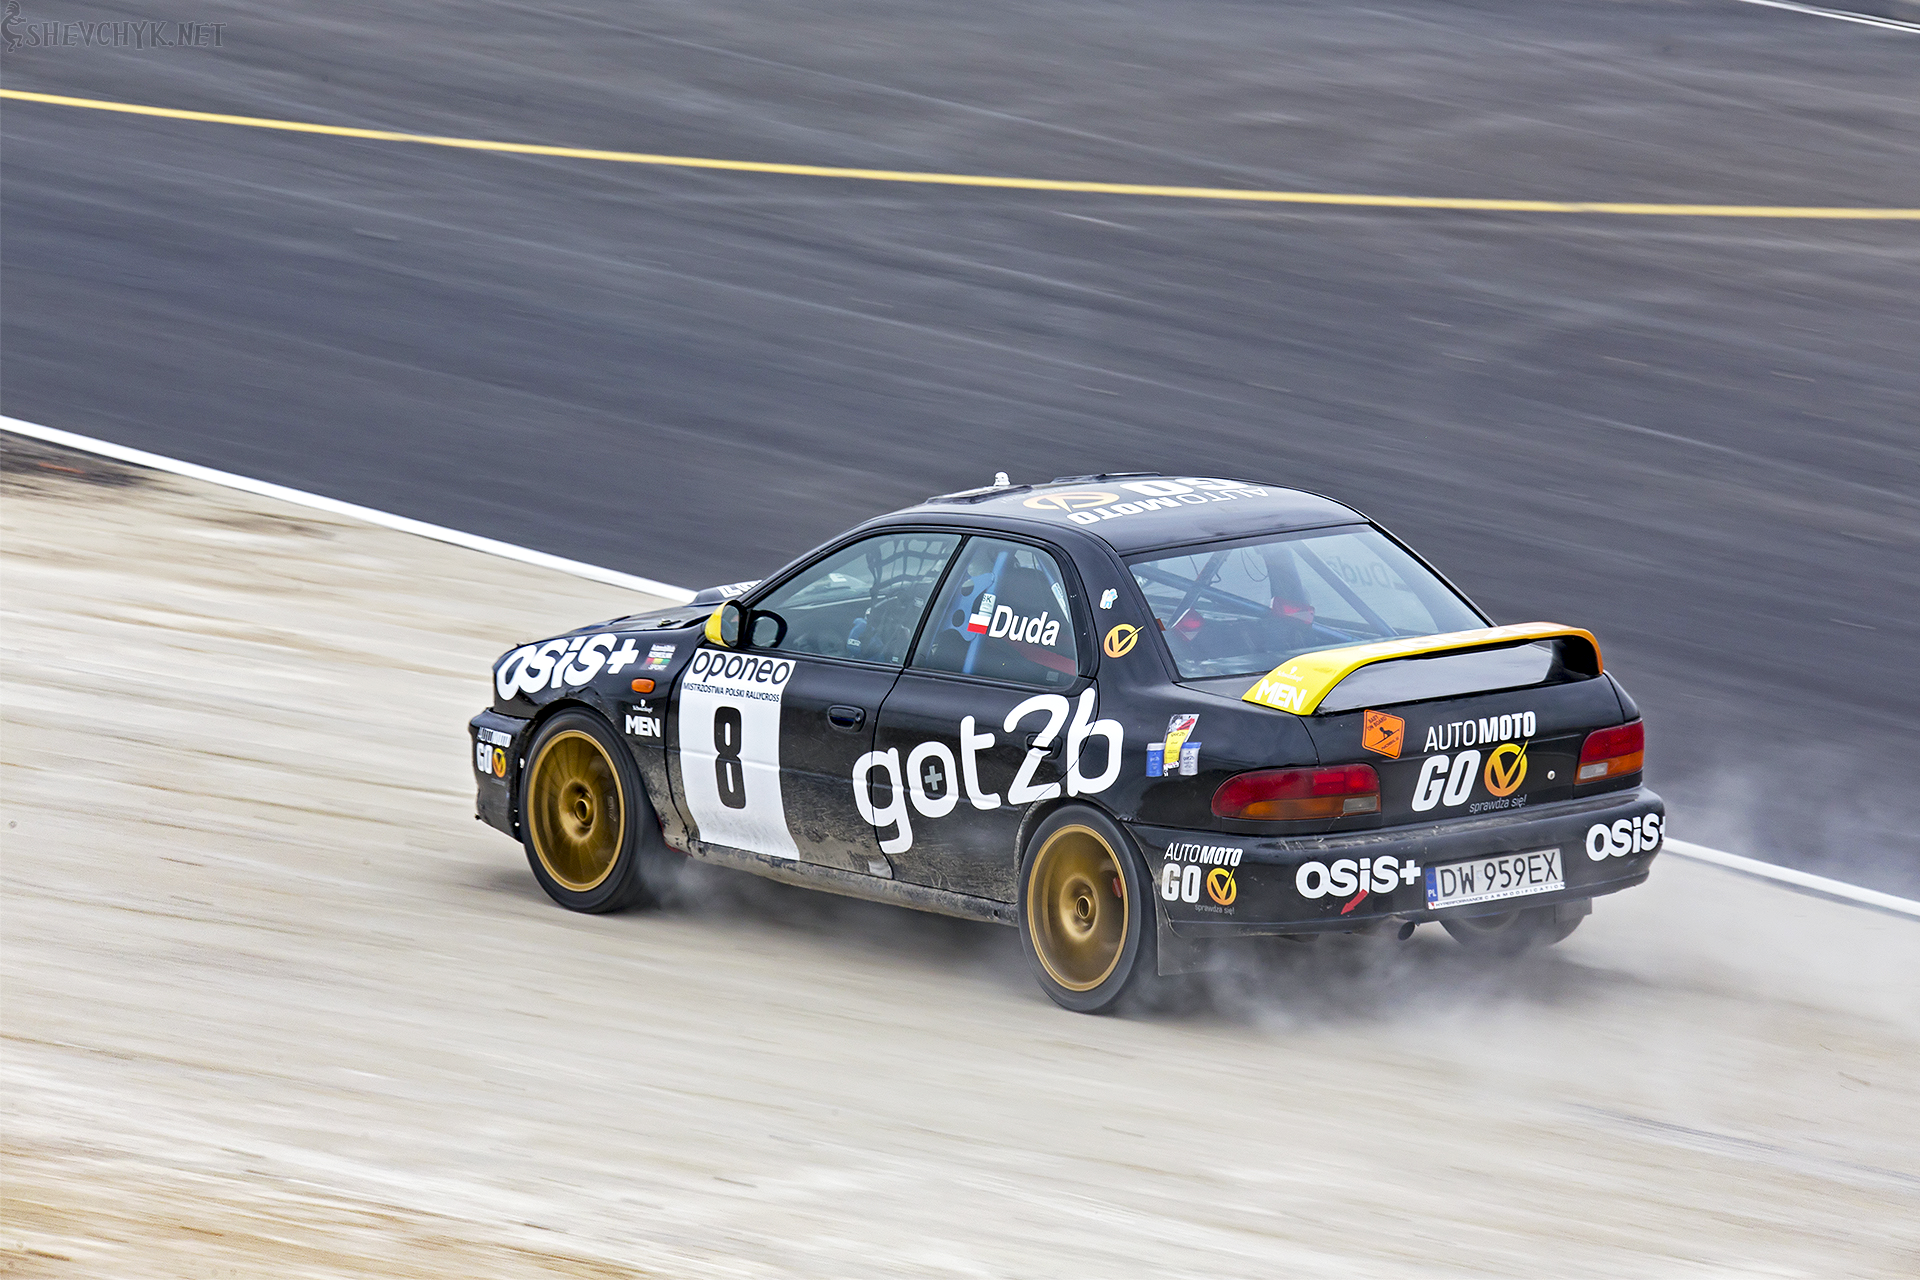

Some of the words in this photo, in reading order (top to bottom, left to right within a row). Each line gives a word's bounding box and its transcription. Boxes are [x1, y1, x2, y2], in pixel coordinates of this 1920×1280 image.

[988, 604, 1060, 647] Duda
[692, 651, 790, 685] oponeo
[683, 682, 724, 695] MISTRZOSTWA
[725, 687, 745, 698] POLSKI
[745, 691, 780, 703] RALLYCROSS
[1254, 679, 1308, 712] MEN
[625, 714, 661, 738] MEN
[1423, 711, 1537, 753] AUTOMOTO
[714, 706, 746, 809] 8
[852, 687, 1124, 854] got2b
[1411, 749, 1481, 812] GO
[1469, 797, 1510, 814] sprawdza
[1163, 842, 1244, 867] AUTOMOTO
[1161, 863, 1202, 903] GO
[1440, 865, 1475, 898] DW
[1484, 852, 1558, 891] 959EX
[1195, 903, 1223, 914] sprawdza
[1427, 889, 1437, 898] PL
